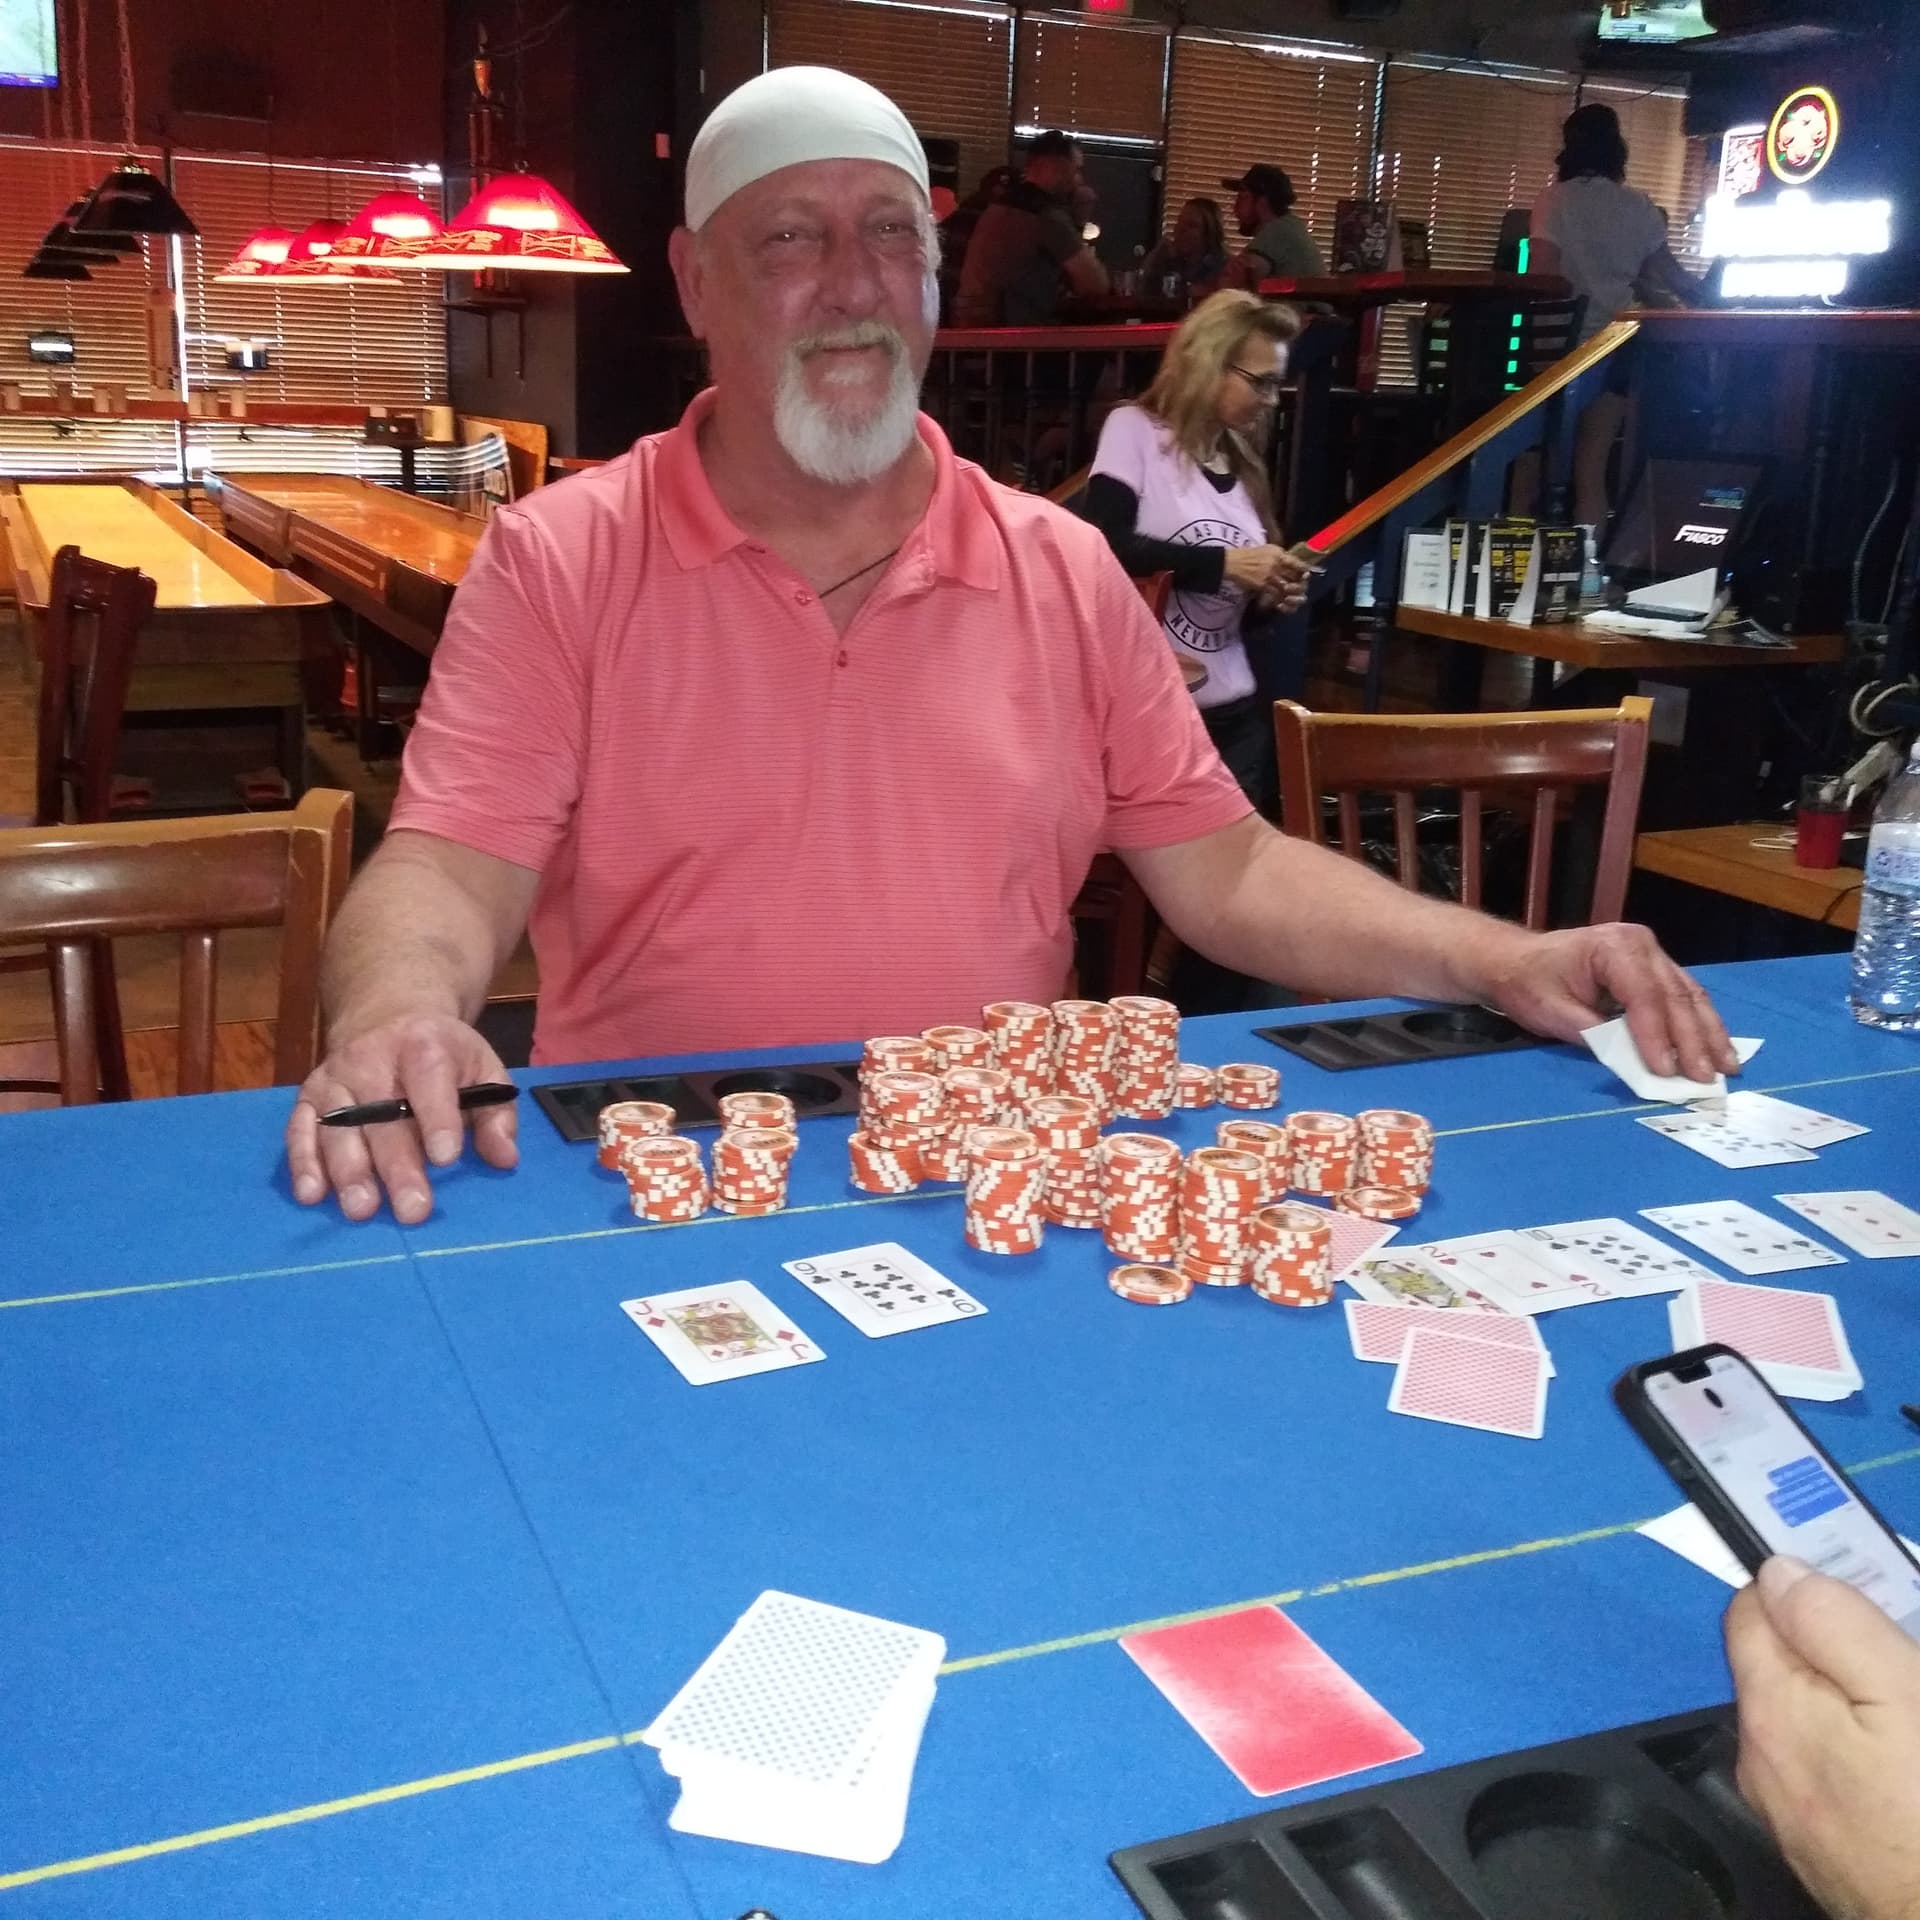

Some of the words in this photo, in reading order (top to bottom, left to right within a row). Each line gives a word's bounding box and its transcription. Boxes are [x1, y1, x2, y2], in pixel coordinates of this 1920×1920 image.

[1180, 523, 1211, 545] LAS
[1420, 1245, 1448, 1258] 2
[793, 1262, 817, 1276] 9
[1580, 1282, 1612, 1297] 2
[634, 1299, 653, 1316] J
